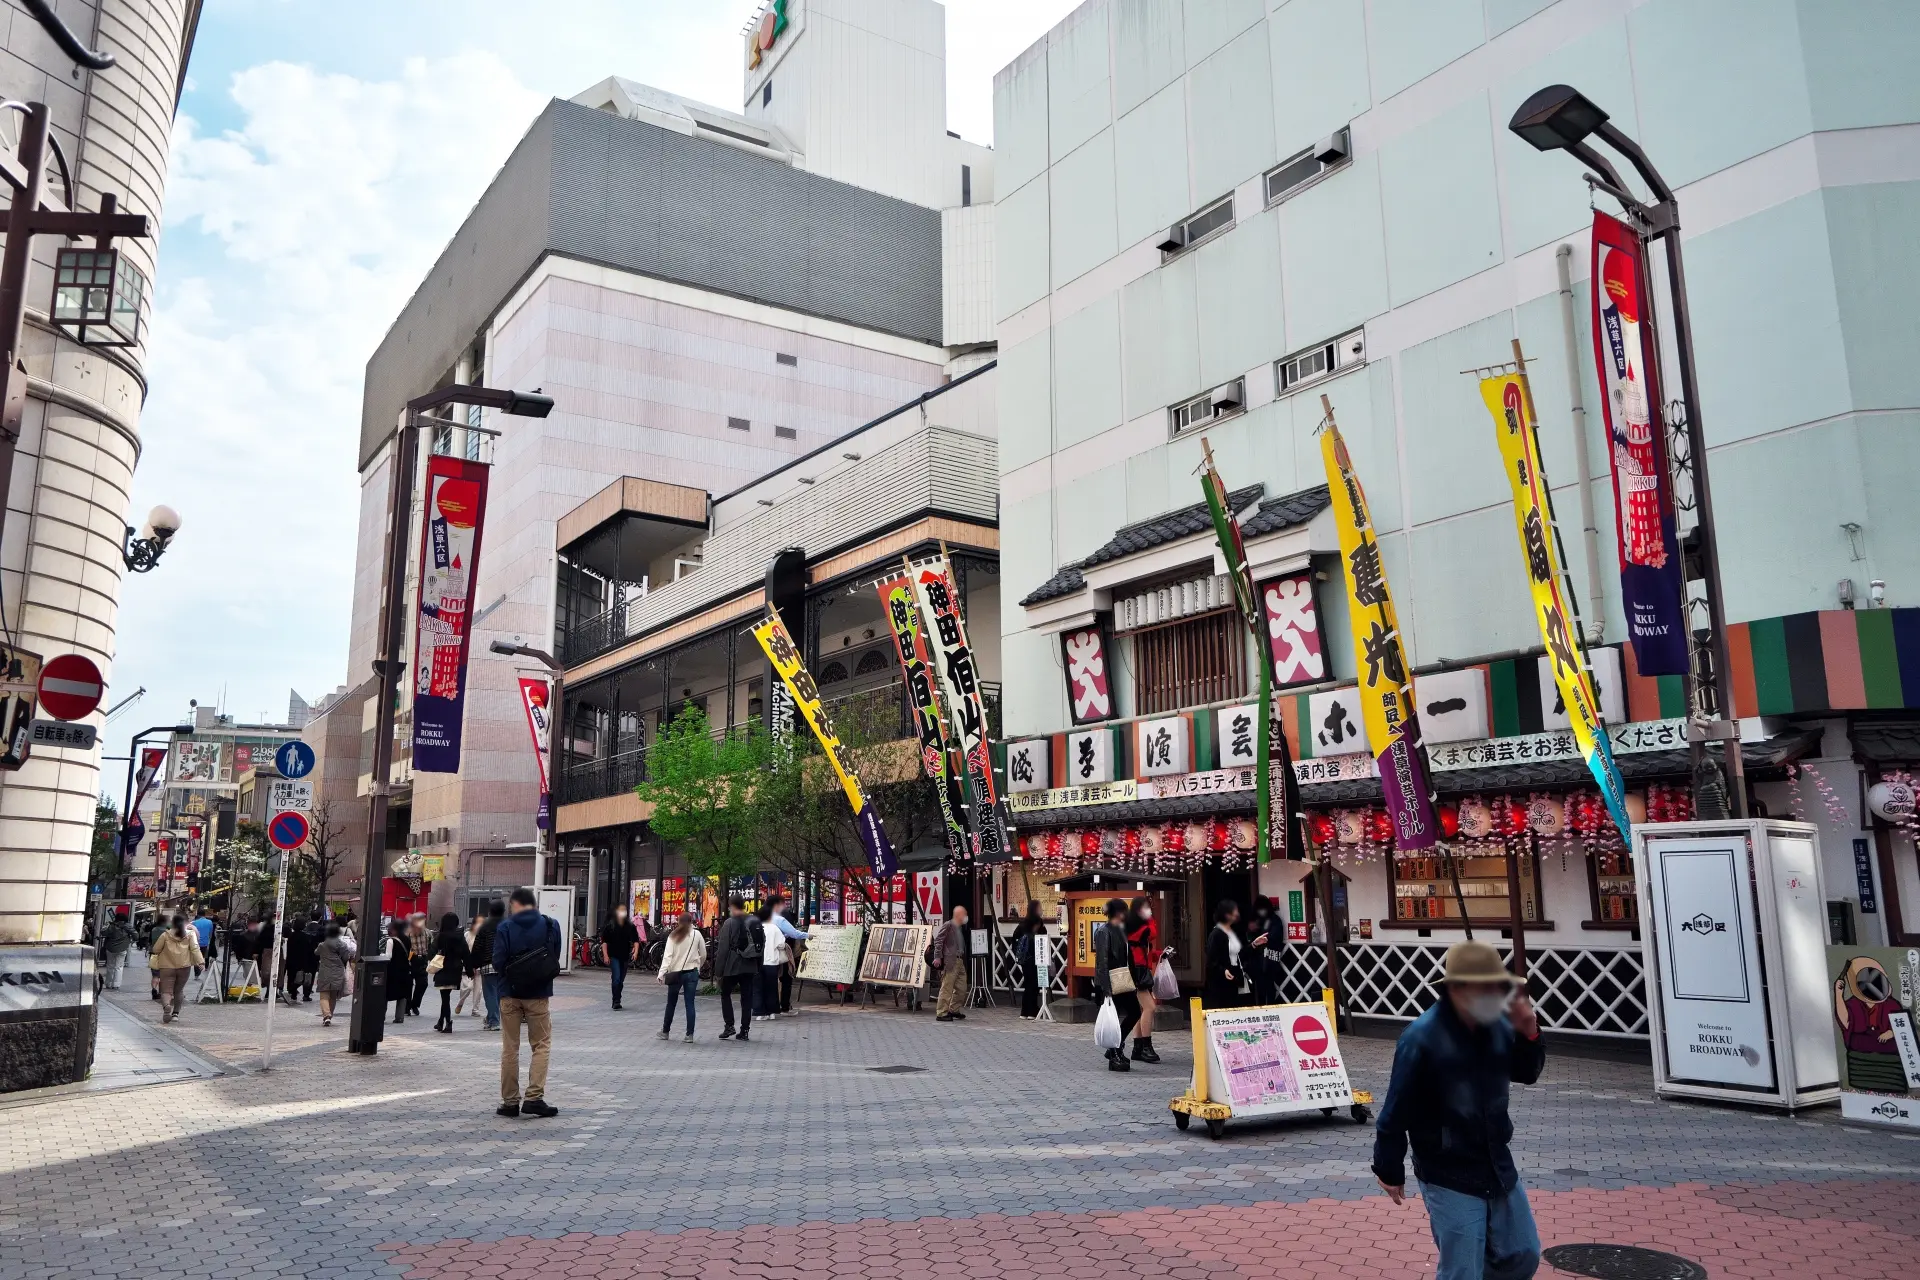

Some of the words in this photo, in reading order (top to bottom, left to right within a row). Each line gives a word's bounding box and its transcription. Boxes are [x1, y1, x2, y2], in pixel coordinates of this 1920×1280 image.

[434, 524, 447, 563] 浅草六区
[1265, 579, 1324, 684] 大入
[432, 634, 463, 648] ROKKU
[1066, 632, 1111, 720] 大入
[771, 681, 780, 739] PACHINKO
[1382, 692, 1405, 736] 師匠へ
[33, 725, 91, 744] 自転車を除く
[416, 737, 451, 747] BROADWAY
[420, 730, 443, 738] ROKKU
[1009, 785, 1134, 808] いの殿堂！浅草演芸ホール
[1391, 741, 1425, 836] 浅草演芸ホール
[1398, 811, 1411, 840] より
[1862, 900, 1874, 909] 43
[1289, 925, 1307, 937] 禁煙
[1697, 1023, 1724, 1031] Welcome
[1698, 1033, 1733, 1044] ROKKU
[1689, 1044, 1745, 1057] BROADWAY
[1299, 1056, 1340, 1071] 進入禁止
